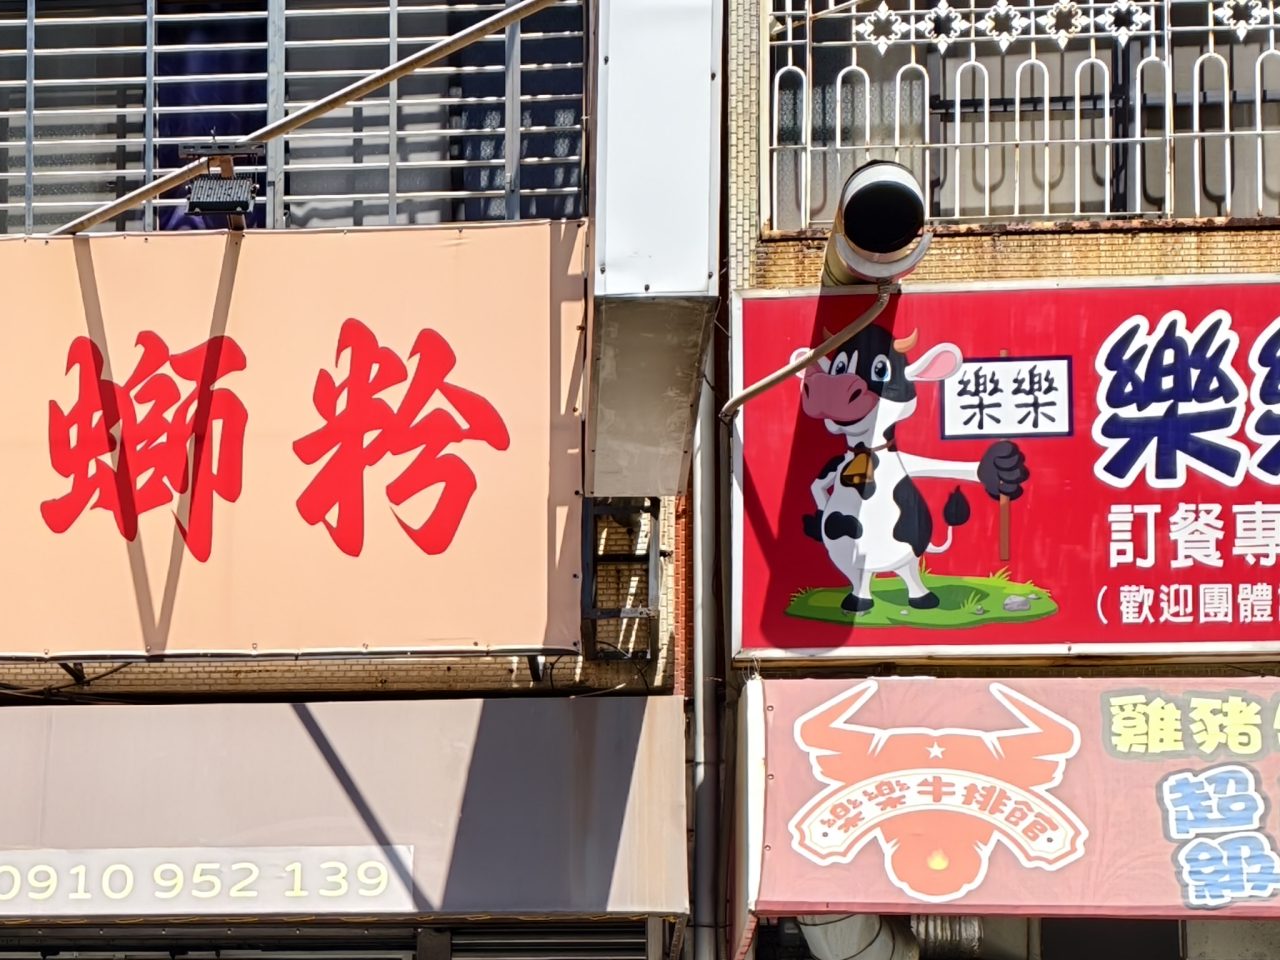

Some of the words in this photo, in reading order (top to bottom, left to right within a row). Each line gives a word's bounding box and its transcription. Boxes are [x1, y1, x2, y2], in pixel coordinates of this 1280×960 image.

[956, 363, 1059, 430] 樂樂
[1096, 583, 1280, 626] (歡迎團體
[1108, 693, 1280, 754] 雞豬
[819, 775, 1061, 844] 樂樂牛排館
[152, 861, 260, 899] 952
[283, 860, 390, 898] 139
